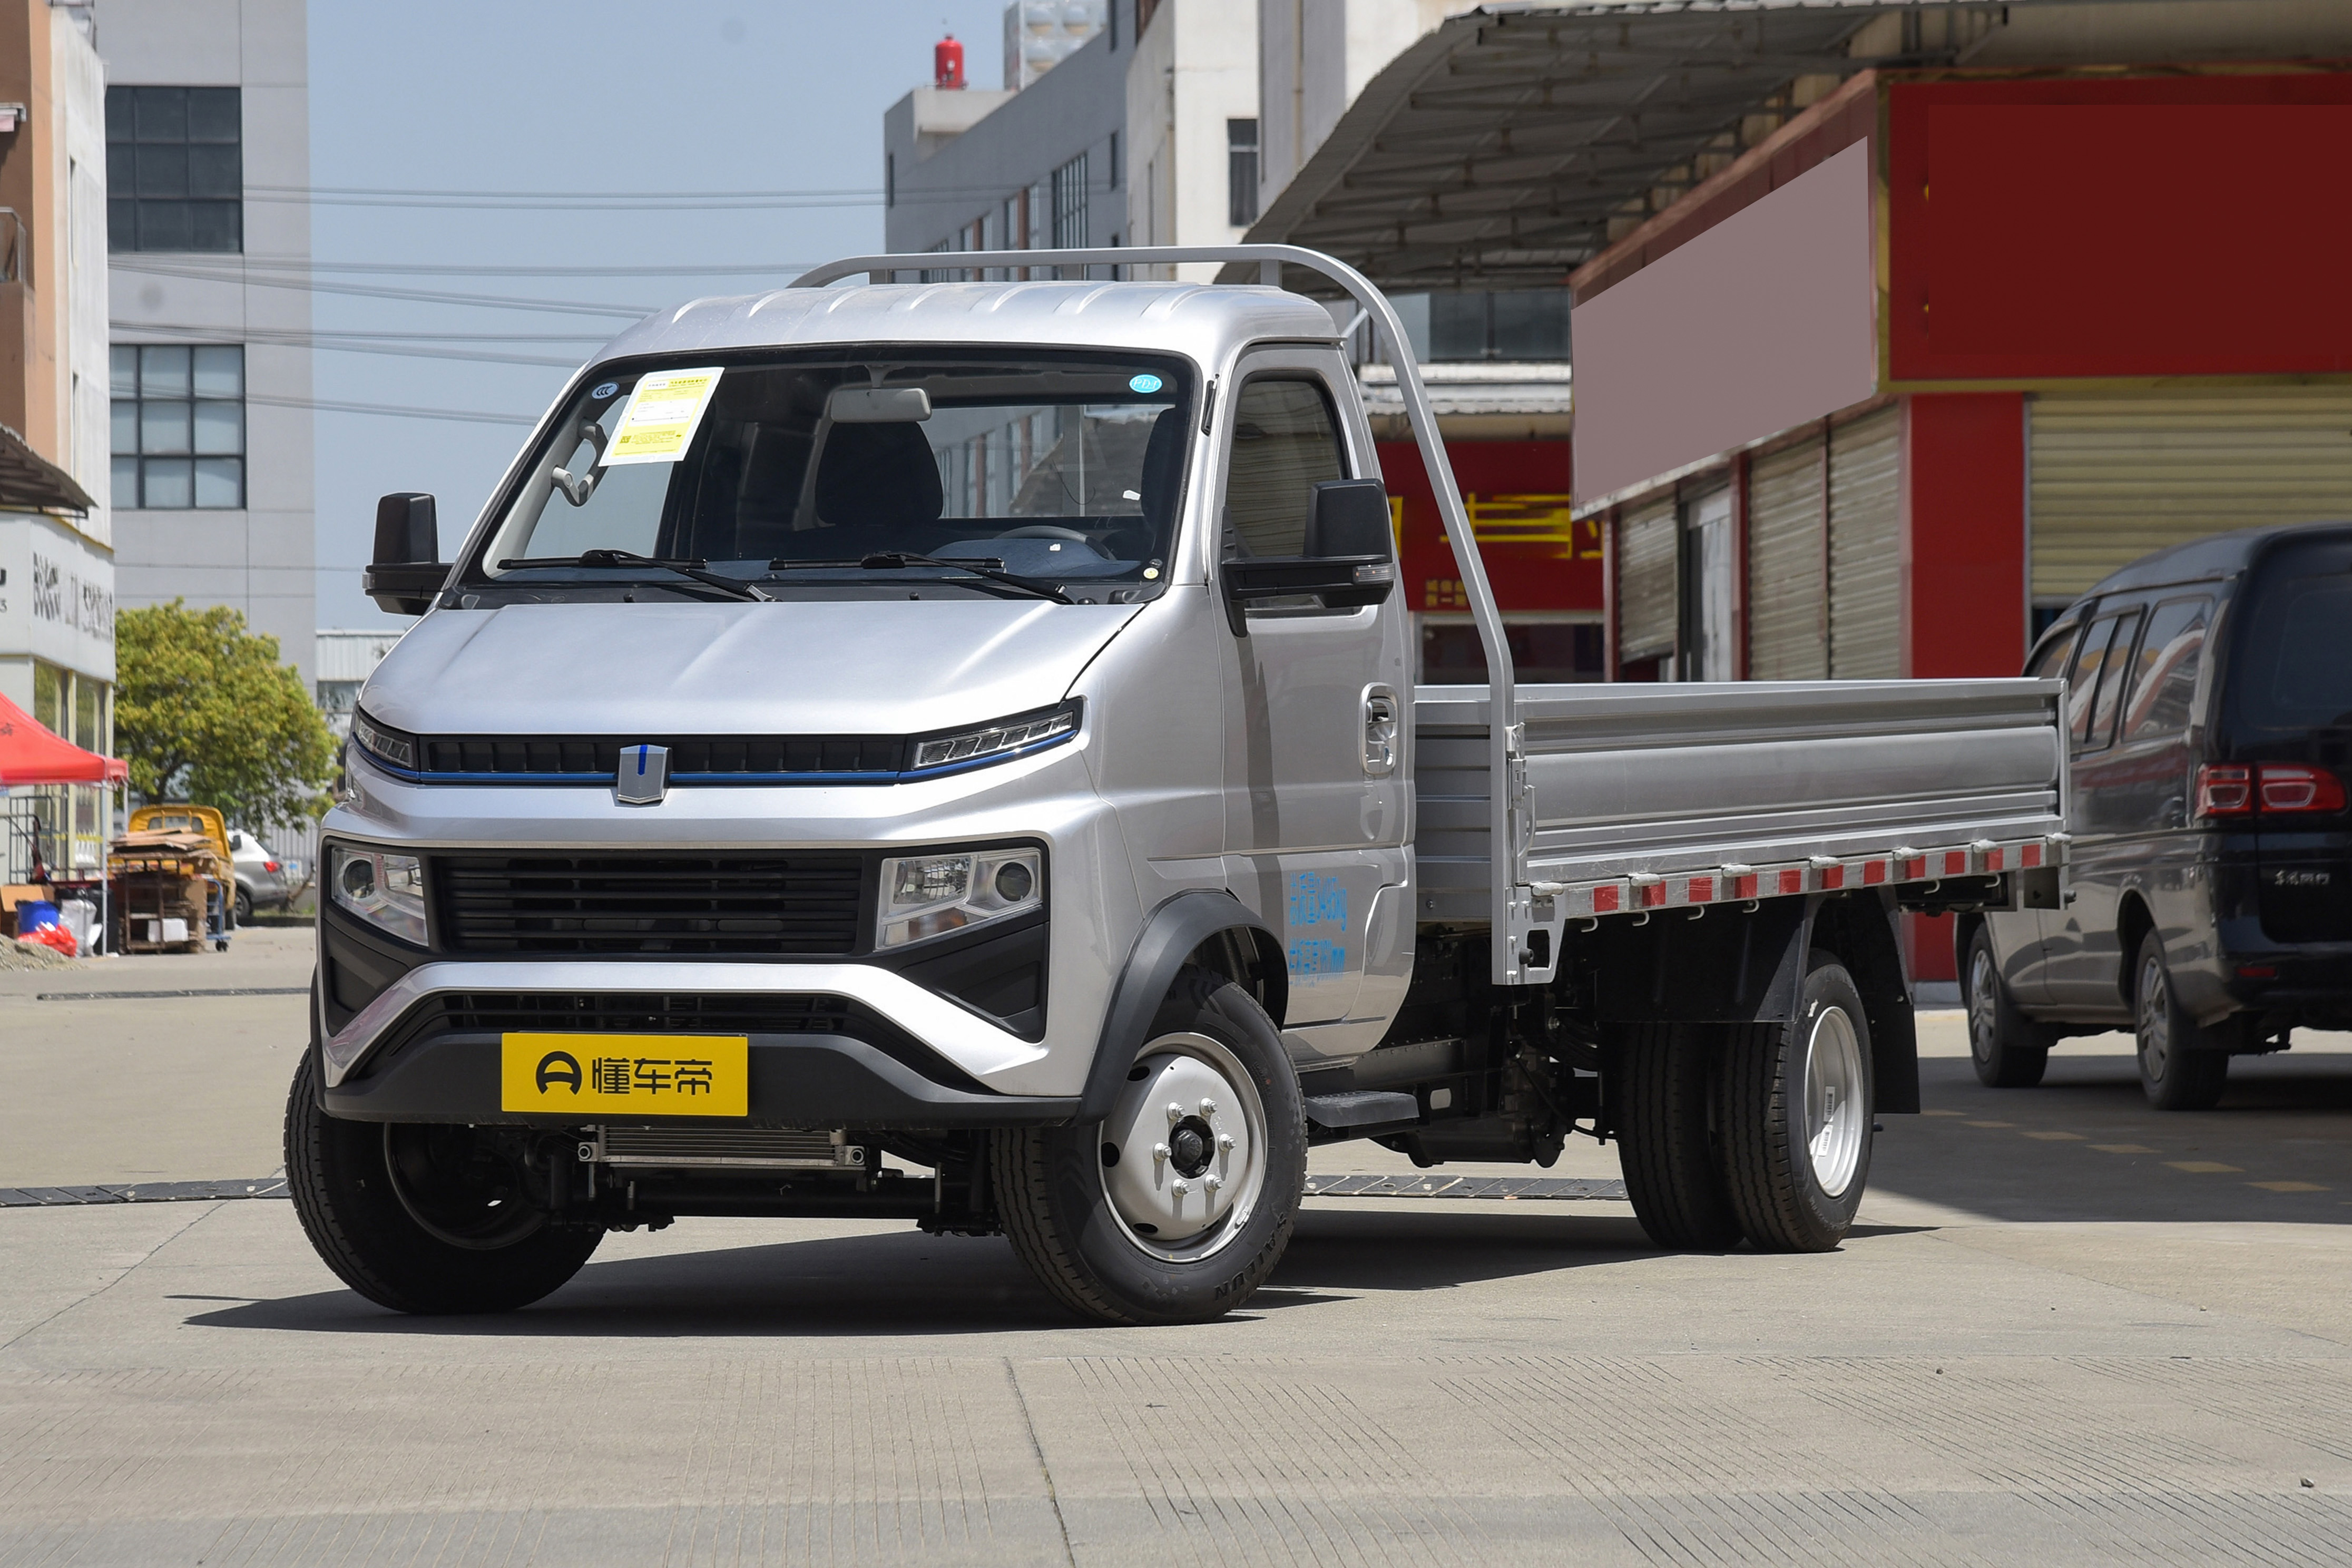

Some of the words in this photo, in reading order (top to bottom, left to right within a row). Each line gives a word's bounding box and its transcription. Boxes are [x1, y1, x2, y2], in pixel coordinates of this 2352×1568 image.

[1133, 378, 1158, 389] PDI
[592, 1057, 713, 1096] 懂车帝
[1214, 1212, 1287, 1301] SAILUN
